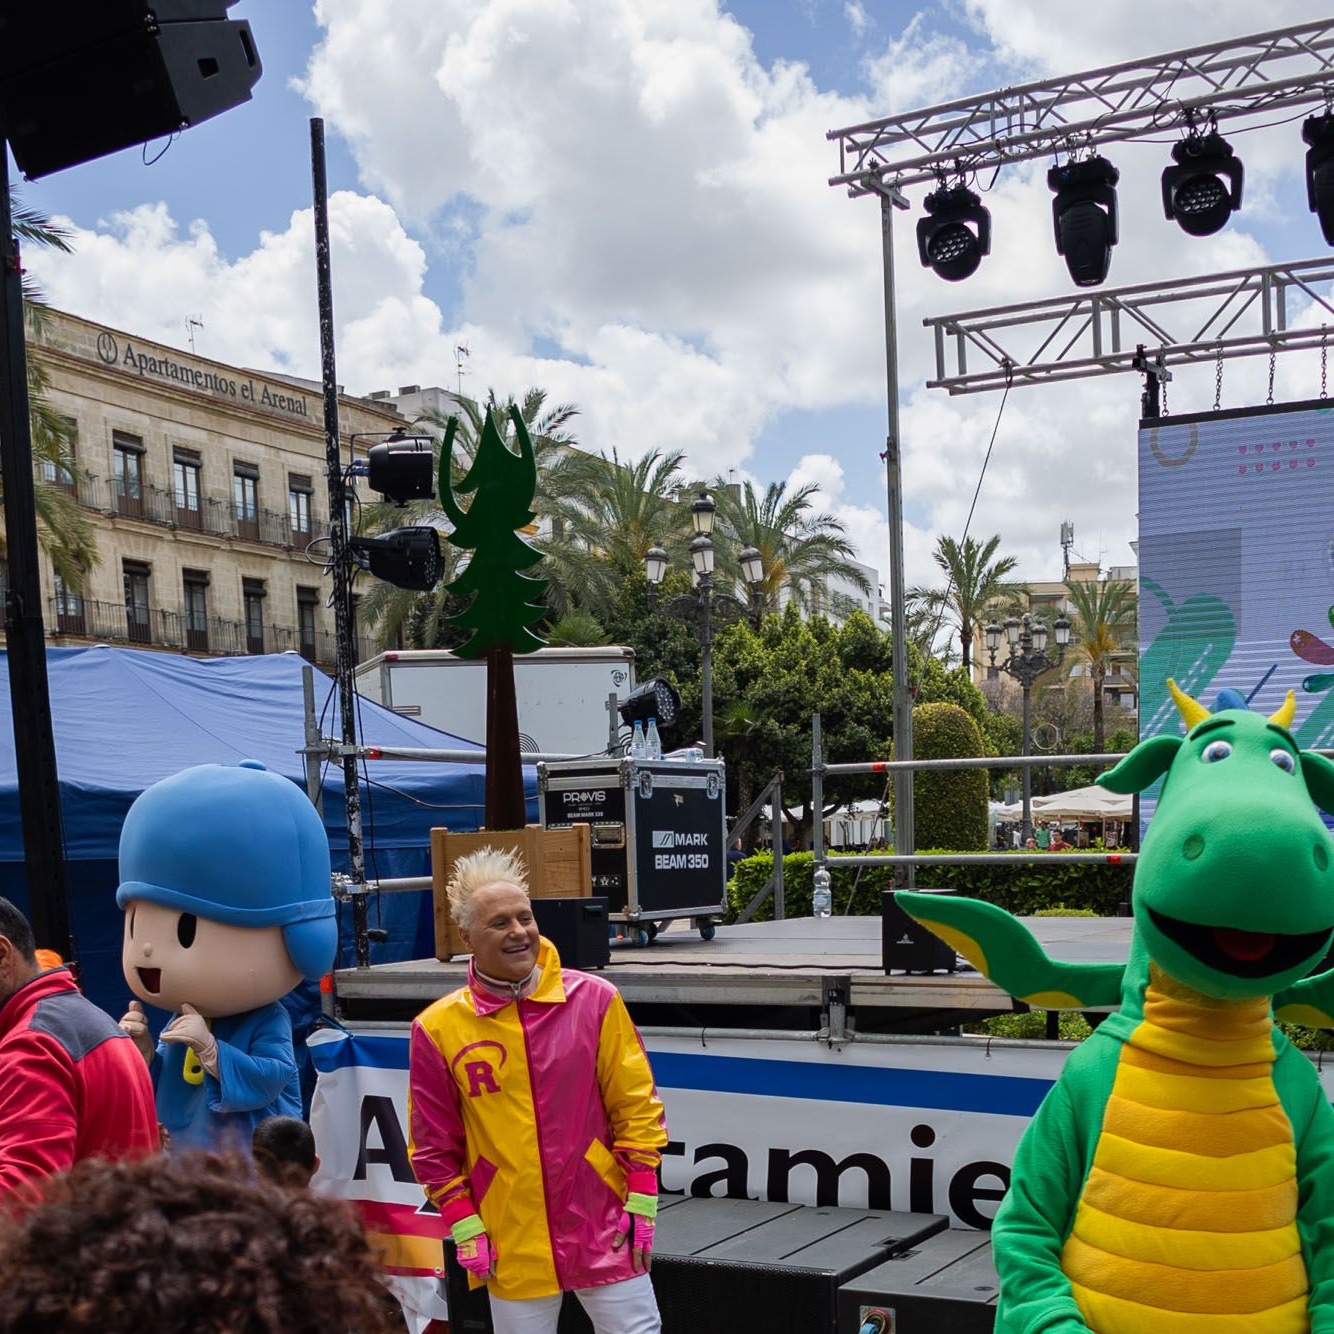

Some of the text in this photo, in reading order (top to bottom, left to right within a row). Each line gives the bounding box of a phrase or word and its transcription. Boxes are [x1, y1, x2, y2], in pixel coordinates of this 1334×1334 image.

[123, 343, 308, 416] Apartamentos el Arenal
[675, 832, 708, 846] MARK
[655, 854, 709, 870] BEAM 350
[464, 1060, 501, 1097] R
